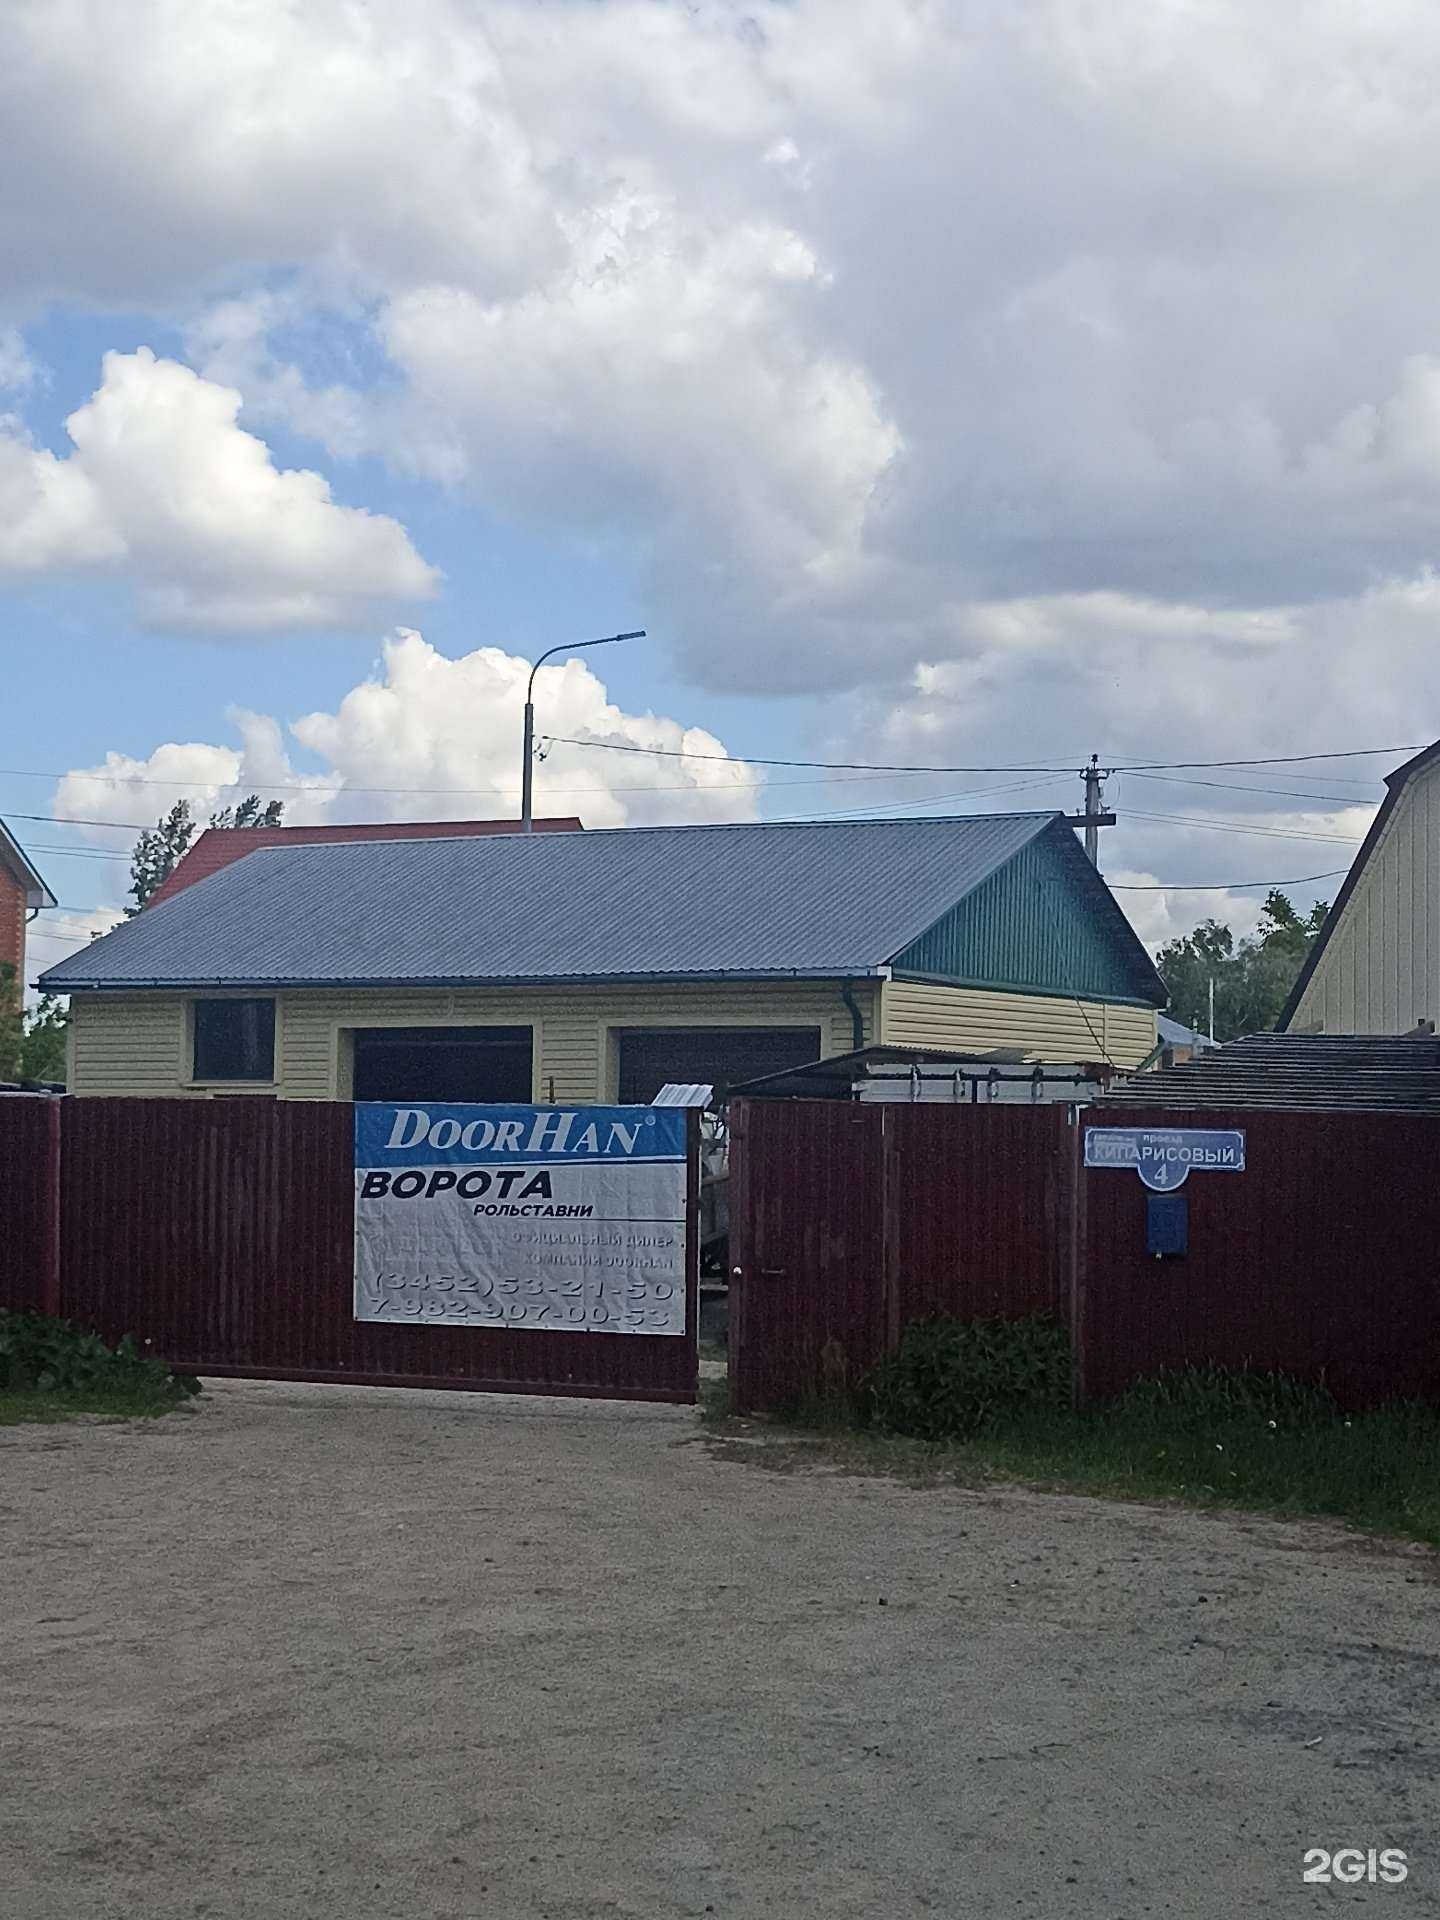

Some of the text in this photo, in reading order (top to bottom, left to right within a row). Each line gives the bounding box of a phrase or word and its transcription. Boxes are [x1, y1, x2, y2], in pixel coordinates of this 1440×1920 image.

[1094, 1145, 1235, 1162] КИПАРИСОВЫЙ
[1154, 1164, 1169, 1185] 4
[360, 1170, 553, 1199] ВОРОТА
[473, 1204, 594, 1217] РОЛЬСТАВНИ
